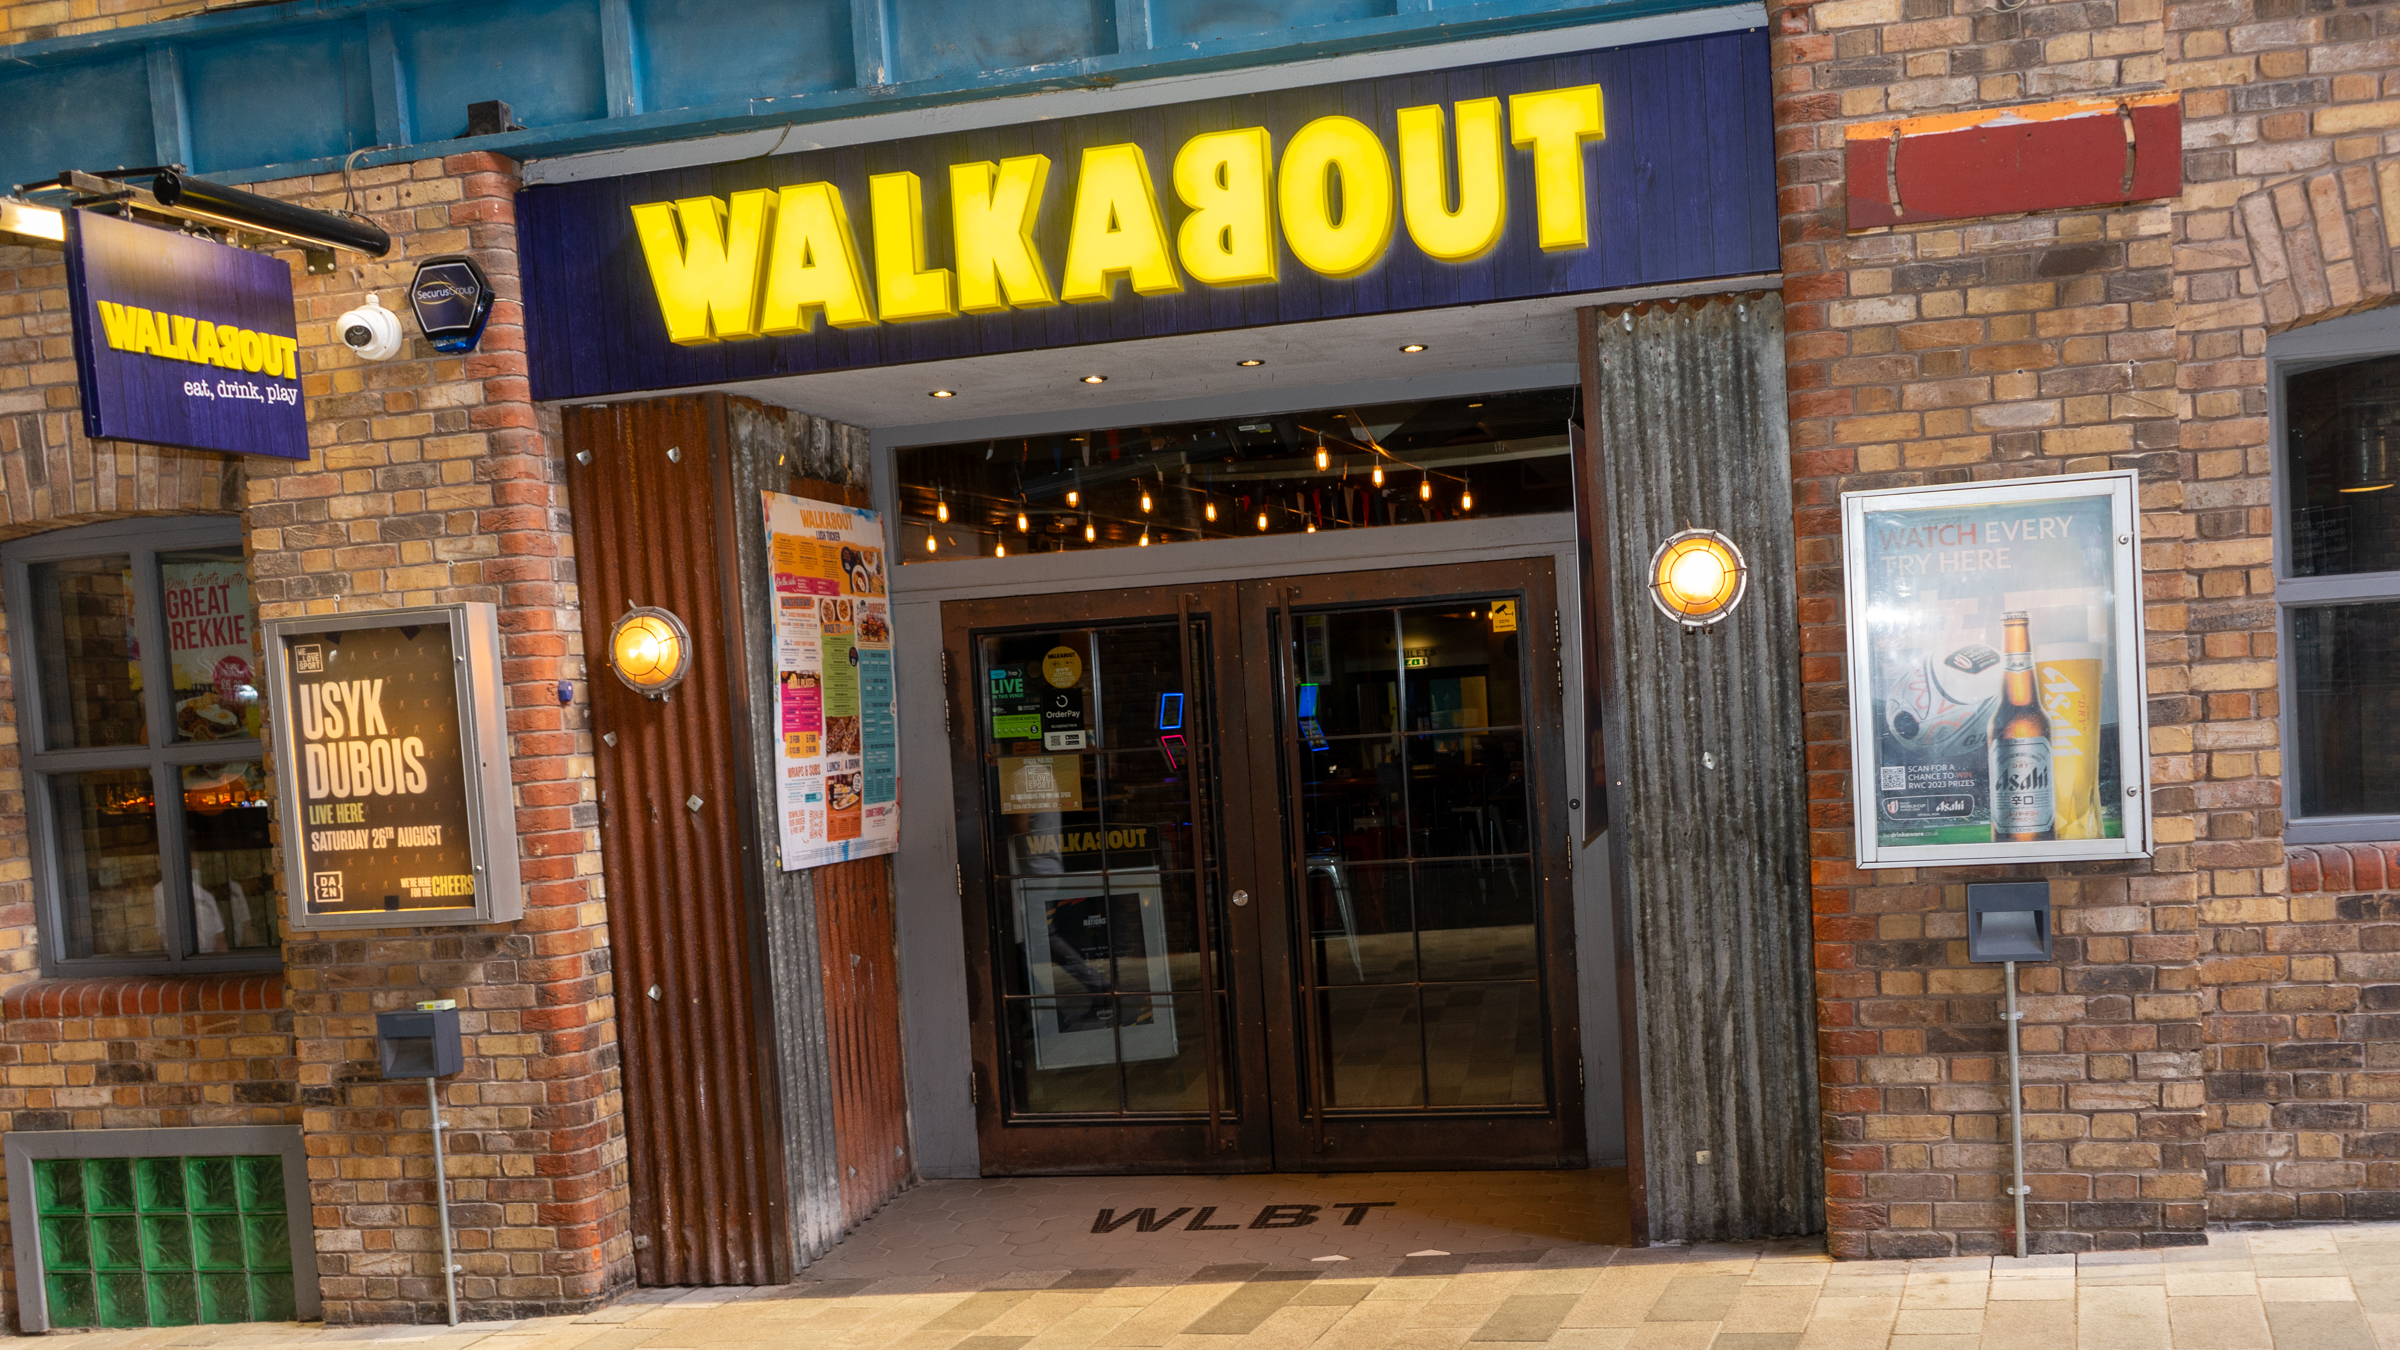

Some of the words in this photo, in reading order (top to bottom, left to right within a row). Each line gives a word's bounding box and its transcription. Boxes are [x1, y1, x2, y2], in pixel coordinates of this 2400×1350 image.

[631, 84, 1605, 345] WALKABOUT
[97, 300, 298, 380] WALKABOUT
[184, 379, 215, 400] eat,
[217, 380, 265, 402] drink,
[266, 384, 298, 406] play
[800, 510, 853, 531] WALKABOUT
[1879, 523, 1977, 551] WATCH
[1985, 516, 2073, 544] EVERY
[1881, 552, 1932, 577] TRY
[1939, 547, 2011, 574] HERE
[166, 584, 230, 619] GREAT
[168, 614, 248, 651] REKKIE
[299, 662, 320, 670] SPORT
[991, 678, 1024, 694] LIVE
[300, 679, 389, 740] USYK
[1046, 710, 1081, 719] OrderPay
[2043, 666, 2084, 757] Asahi
[305, 736, 428, 799] DUBOIS
[788, 765, 804, 778] WRAPS
[1027, 768, 1037, 776] WE
[1032, 774, 1051, 783] LOVE
[1908, 773, 1941, 781] CHANCE
[1943, 772, 1954, 780] TO
[1996, 765, 2048, 792] Asahi
[1028, 782, 1051, 790] SPORT
[309, 804, 334, 825] LIVE
[336, 803, 365, 824] HERE
[1935, 800, 1965, 812] Asahi
[311, 829, 369, 852] SATURDAY
[371, 826, 395, 849] 26TH
[397, 825, 442, 848] AUGUST
[1026, 828, 1147, 855] WALKABOUT
[320, 877, 336, 887] DA
[321, 887, 337, 898] ZN
[411, 888, 421, 898] FOR
[422, 887, 432, 897] THE
[418, 877, 432, 886] HERE
[432, 874, 474, 897] CHEERS
[1090, 1201, 1397, 1234] WLBT
